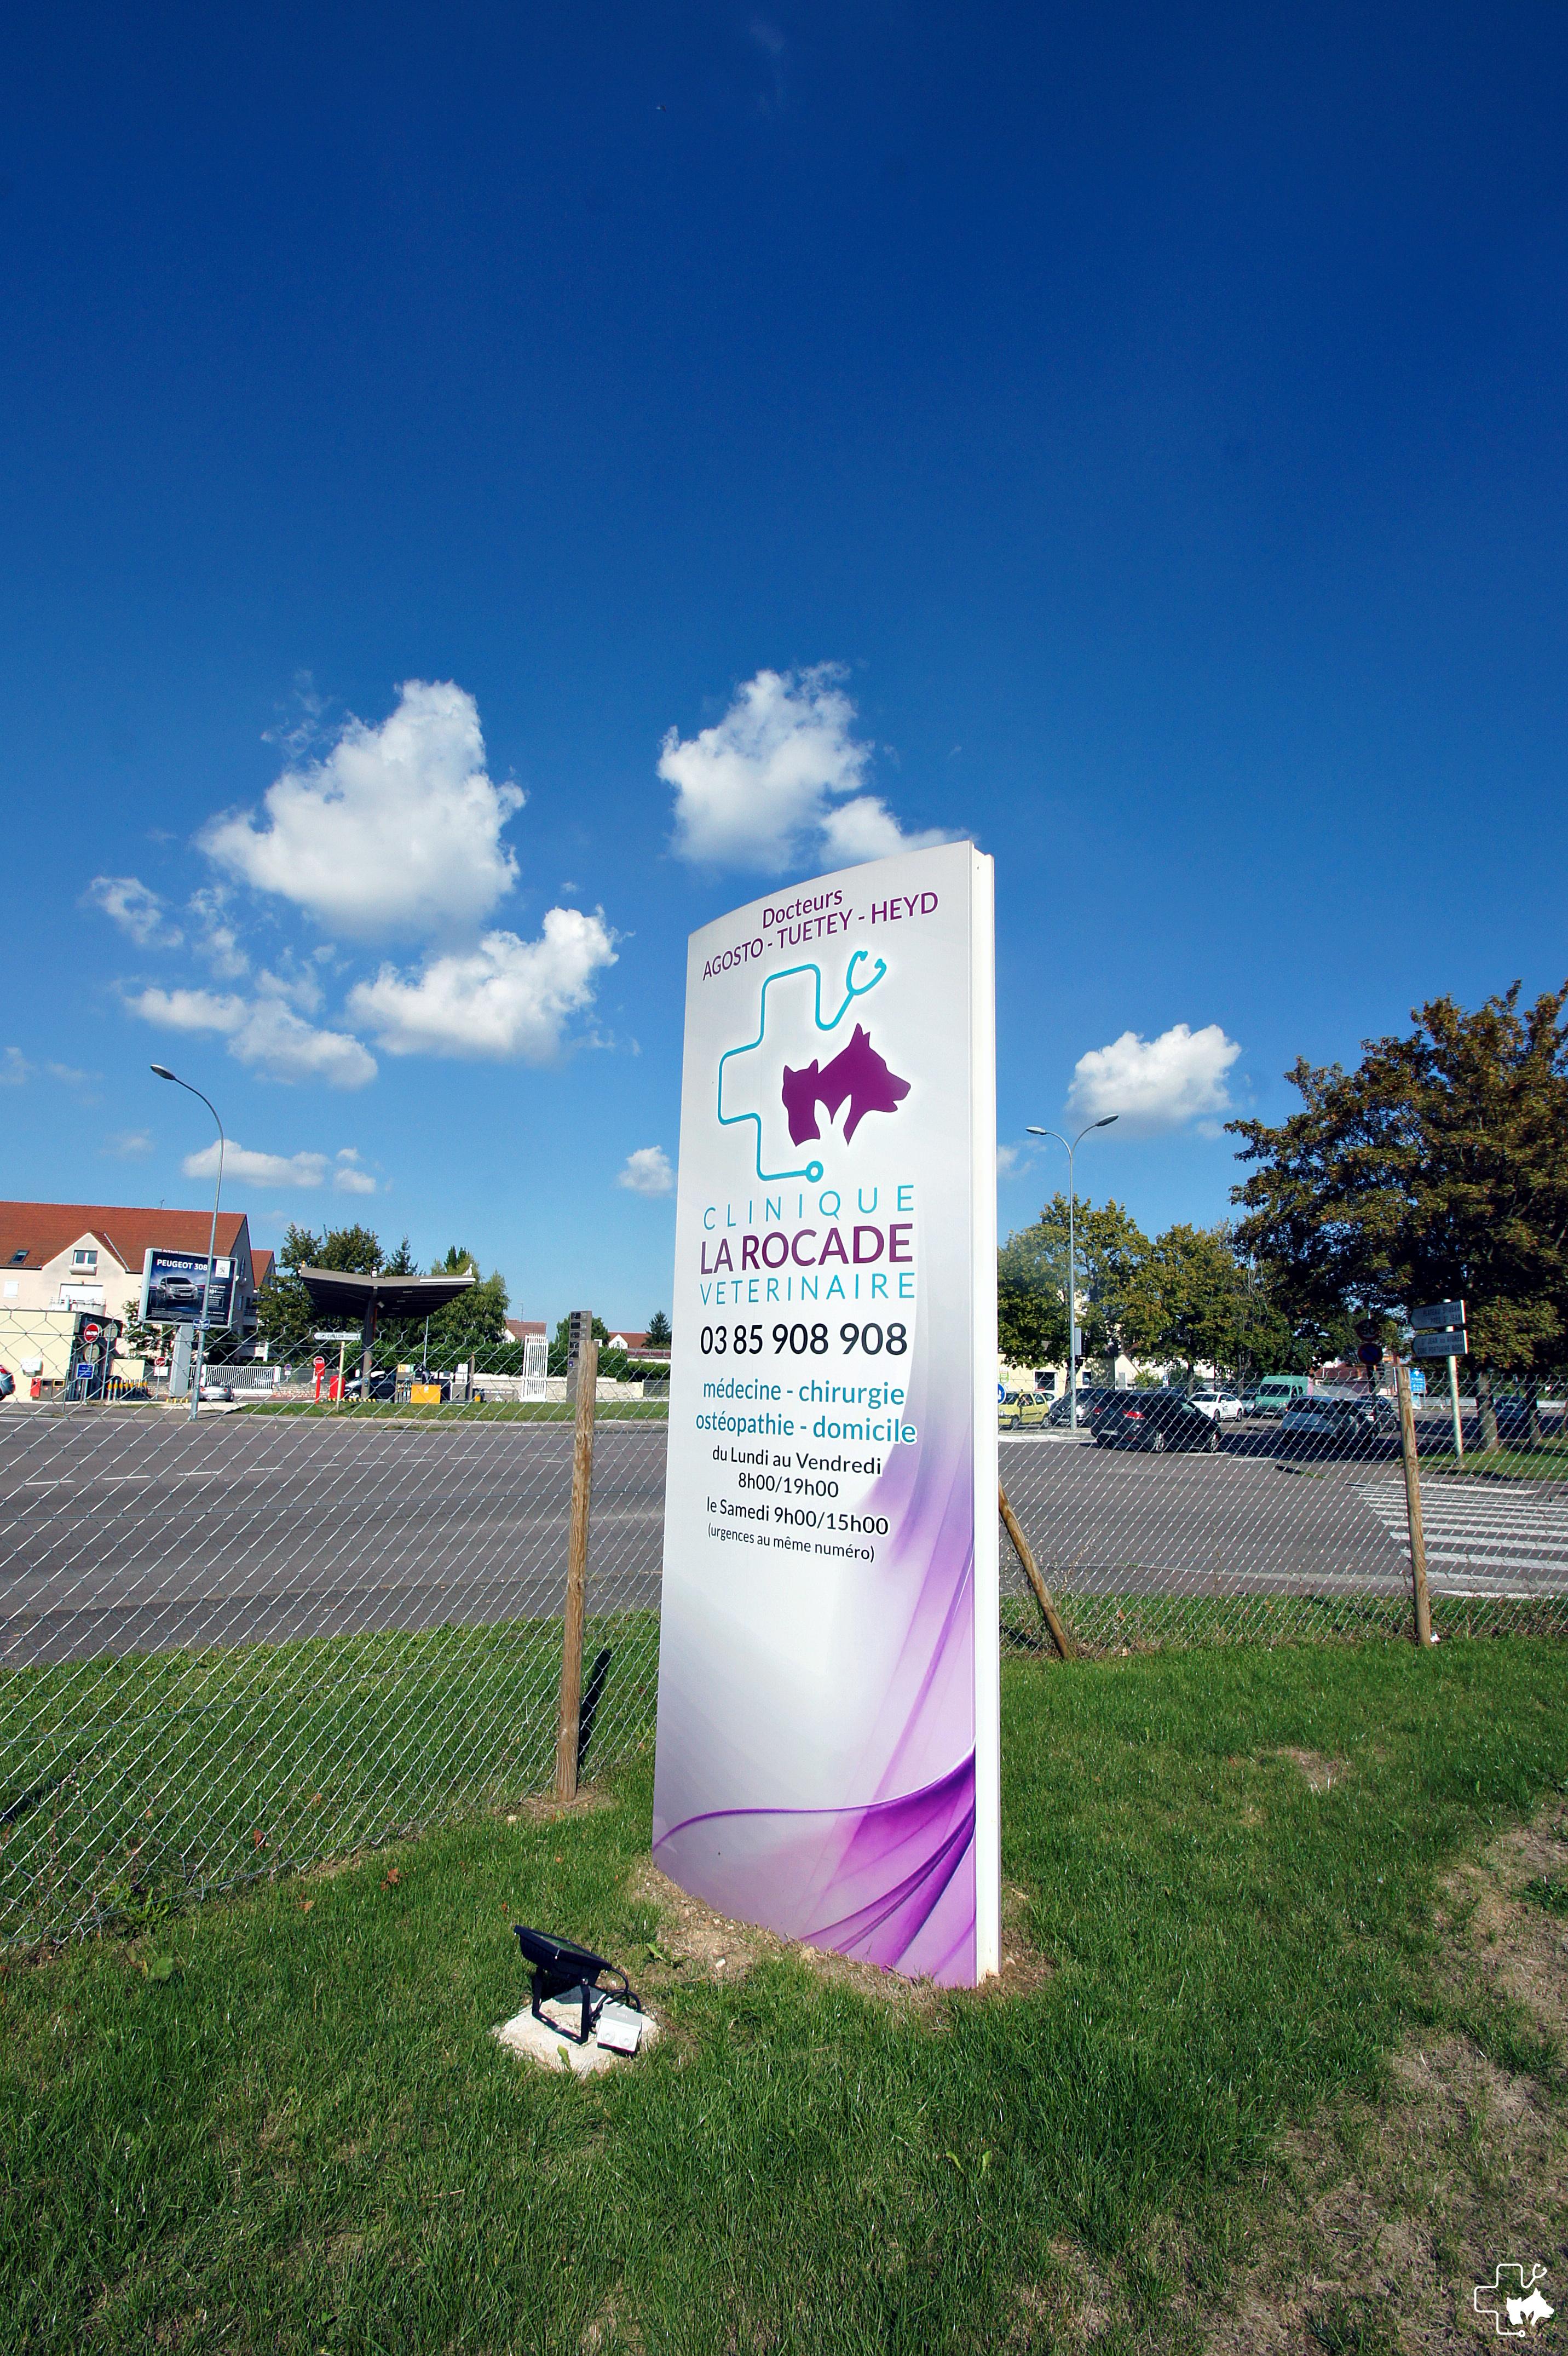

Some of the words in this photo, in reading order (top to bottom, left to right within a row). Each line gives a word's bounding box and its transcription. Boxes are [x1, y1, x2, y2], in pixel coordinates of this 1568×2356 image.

[763, 889, 843, 928] Docteurs
[702, 938, 763, 980] AGOSTO
[777, 909, 853, 949] TUETEY
[872, 892, 938, 924] HEYD
[704, 1185, 914, 1230] CLINIQUE
[157, 1259, 193, 1269] PEUGEOT
[701, 1238, 734, 1275] LA
[742, 1223, 913, 1271] ROCADE
[700, 1272, 915, 1306] VETERINAIRE
[701, 1325, 727, 1354] 03
[733, 1325, 763, 1354] 85
[773, 1323, 828, 1354] 908
[840, 1323, 907, 1355] 908
[704, 1377, 781, 1400] médecine
[799, 1380, 904, 1409] chirurgie
[696, 1411, 794, 1437] ostéopathie
[813, 1415, 915, 1443] domicile
[713, 1445, 727, 1461] du
[731, 1447, 768, 1466] Lundi
[773, 1455, 791, 1468] au
[796, 1452, 880, 1474] Vendredi
[739, 1473, 839, 1498] 8h00/19h00
[707, 1496, 717, 1513] le
[720, 1499, 769, 1521] Samedi
[775, 1507, 888, 1535] 9h00/15h00
[708, 1522, 754, 1543] (urgences
[757, 1536, 770, 1546] au
[774, 1536, 811, 1552] même
[815, 1544, 874, 1563] numéro)
